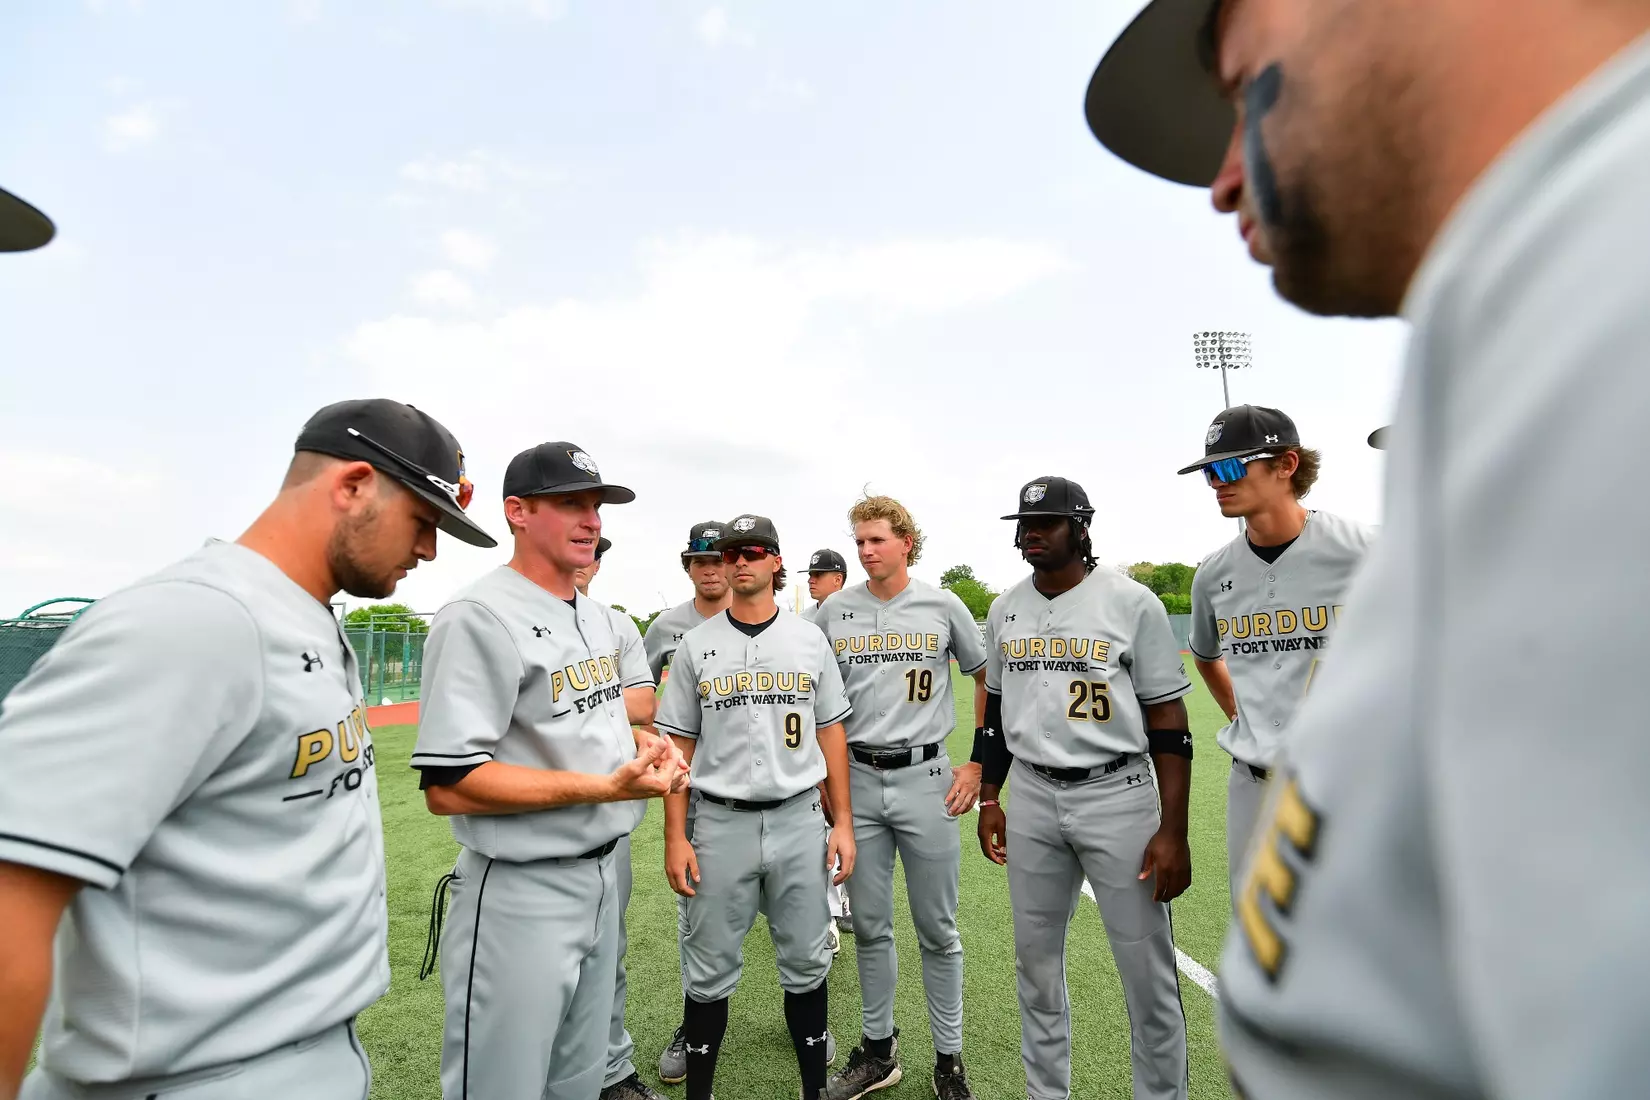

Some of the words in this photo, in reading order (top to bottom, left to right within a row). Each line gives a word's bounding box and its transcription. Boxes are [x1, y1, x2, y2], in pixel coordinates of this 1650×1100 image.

[835, 633, 938, 656] PURDUE
[1231, 640, 1269, 655] FORT
[848, 654, 879, 665] FORT
[881, 652, 923, 663] WAYNE
[1008, 661, 1040, 672] FORT
[1043, 660, 1088, 672] WAYNE
[699, 672, 811, 700] PURDUE
[904, 667, 934, 704] 19
[715, 695, 748, 711] FORT
[751, 694, 795, 705] WAYNE
[1066, 679, 1111, 723] 25
[784, 711, 802, 750] 9
